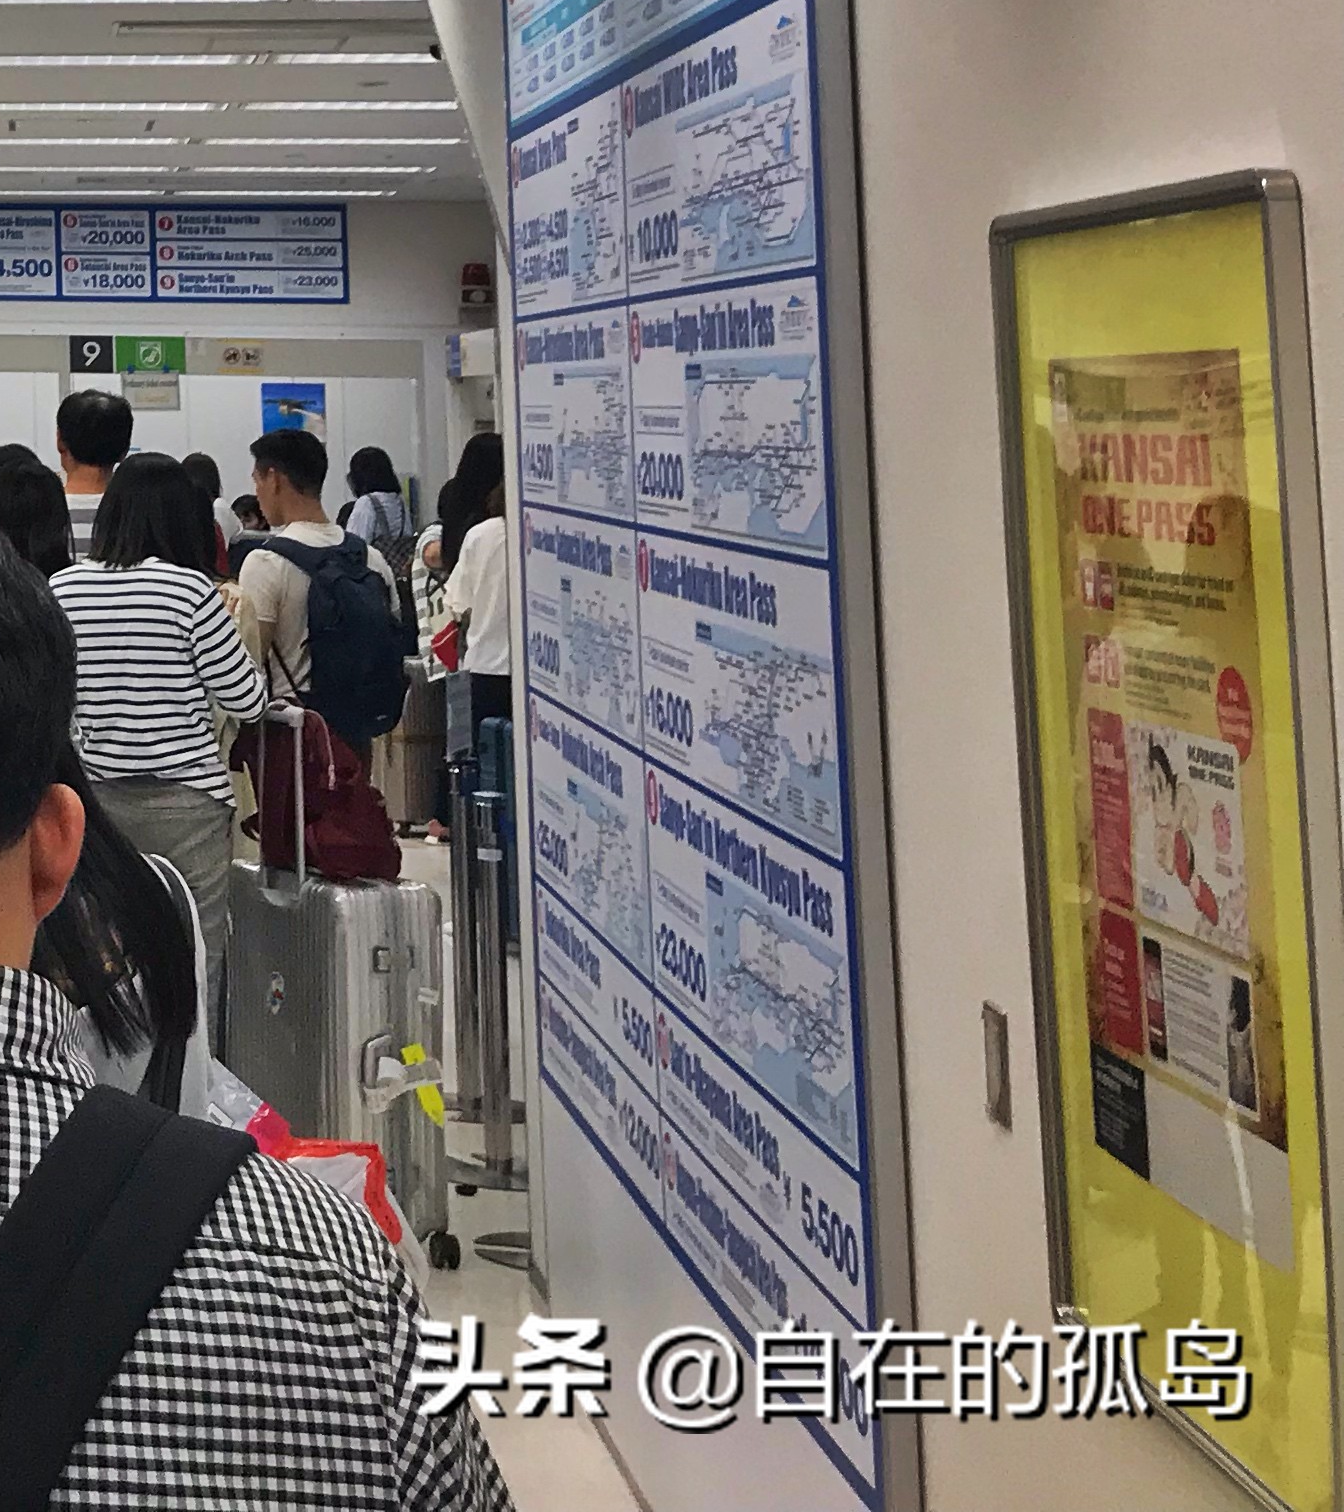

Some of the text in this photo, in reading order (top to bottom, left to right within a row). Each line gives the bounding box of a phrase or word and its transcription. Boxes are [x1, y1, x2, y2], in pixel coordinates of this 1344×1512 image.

[711, 46, 738, 94] Pass
[6, 229, 24, 240] Pass
[81, 231, 144, 246] ¥20,000
[177, 226, 226, 235] Area Pass
[250, 251, 273, 261] Pass
[83, 274, 145, 289] ¥18,000
[750, 298, 775, 347] Pass
[82, 341, 101, 367] 9
[1078, 433, 1212, 486] KANSAI
[1136, 499, 1215, 546] PASS
[749, 571, 777, 628] Pass
[1187, 744, 1234, 773] KANSAI
[801, 868, 834, 937] Pass
[801, 1182, 859, 1286] 5,500
